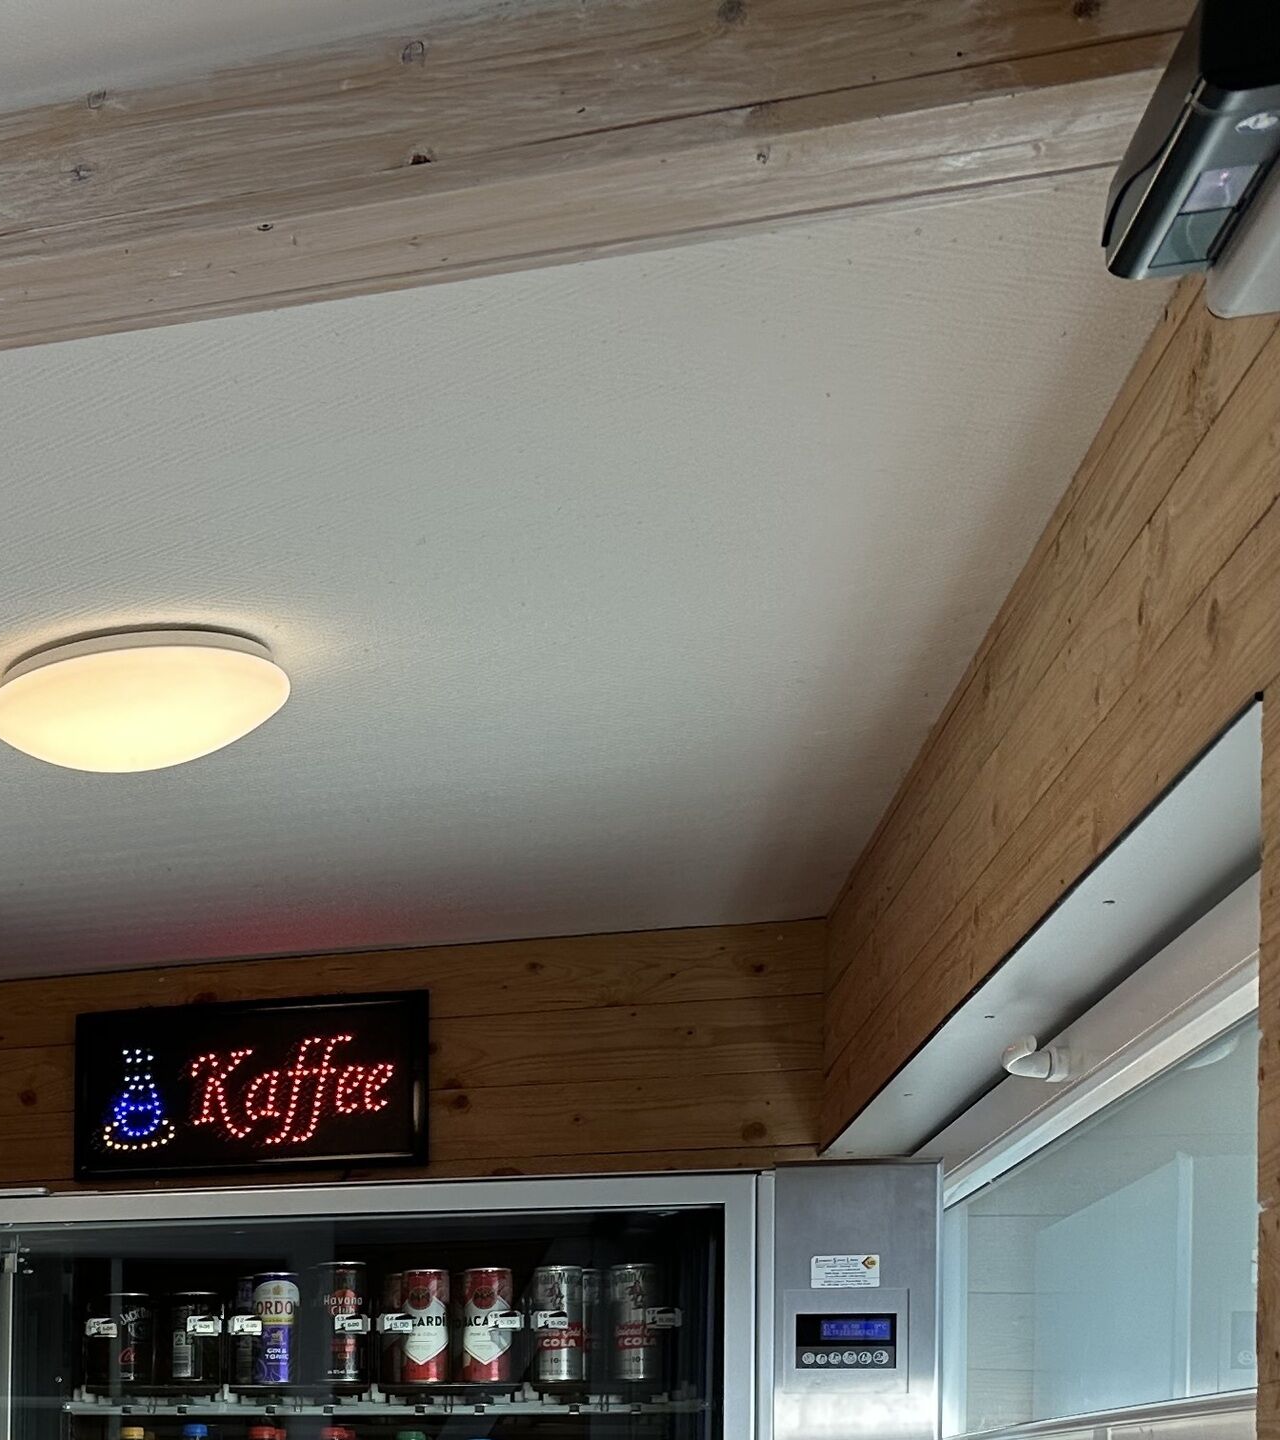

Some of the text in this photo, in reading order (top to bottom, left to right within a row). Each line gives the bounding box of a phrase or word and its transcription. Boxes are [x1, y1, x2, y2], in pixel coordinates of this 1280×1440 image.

[188, 1034, 395, 1145] Kaffee
[463, 1314, 488, 1327] BACA
[543, 1339, 576, 1347] COLA
